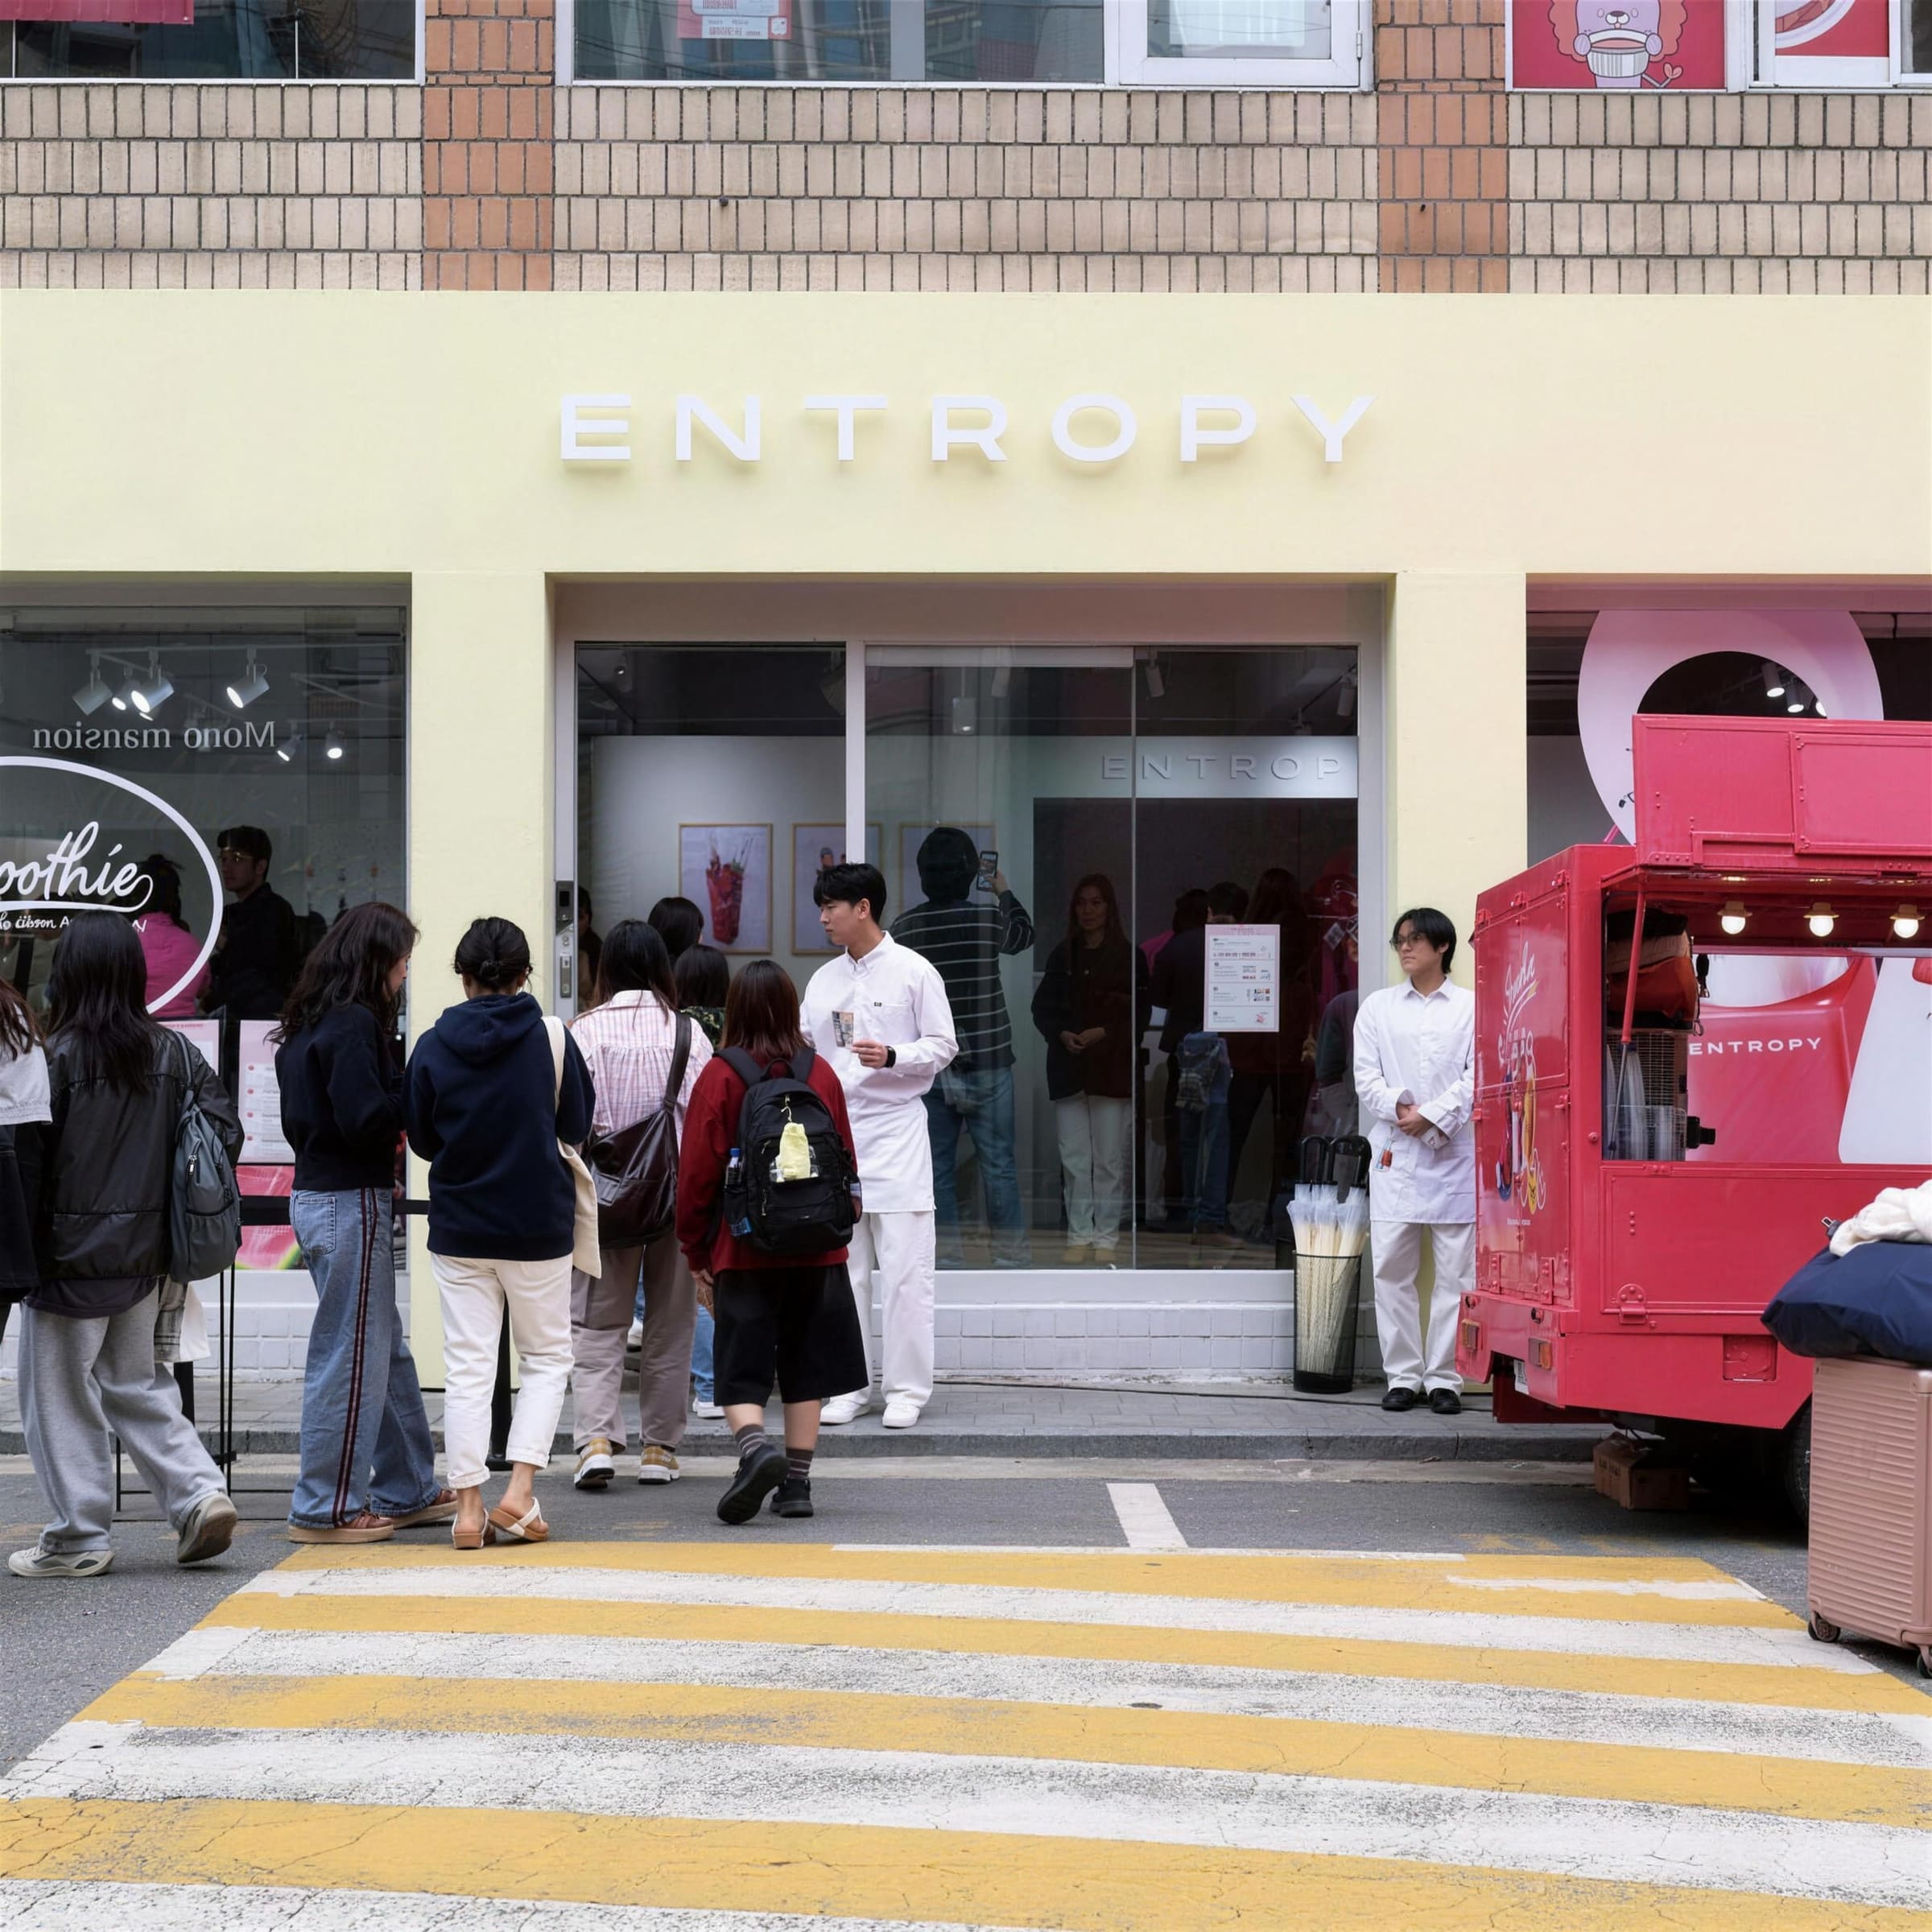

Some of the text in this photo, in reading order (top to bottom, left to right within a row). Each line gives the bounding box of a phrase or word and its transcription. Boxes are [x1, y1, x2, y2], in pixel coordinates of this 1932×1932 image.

[560, 394, 1377, 461] ENTROPY
[1102, 753, 1343, 780] ENTROP
[1689, 1037, 1821, 1055] ENTROPY
